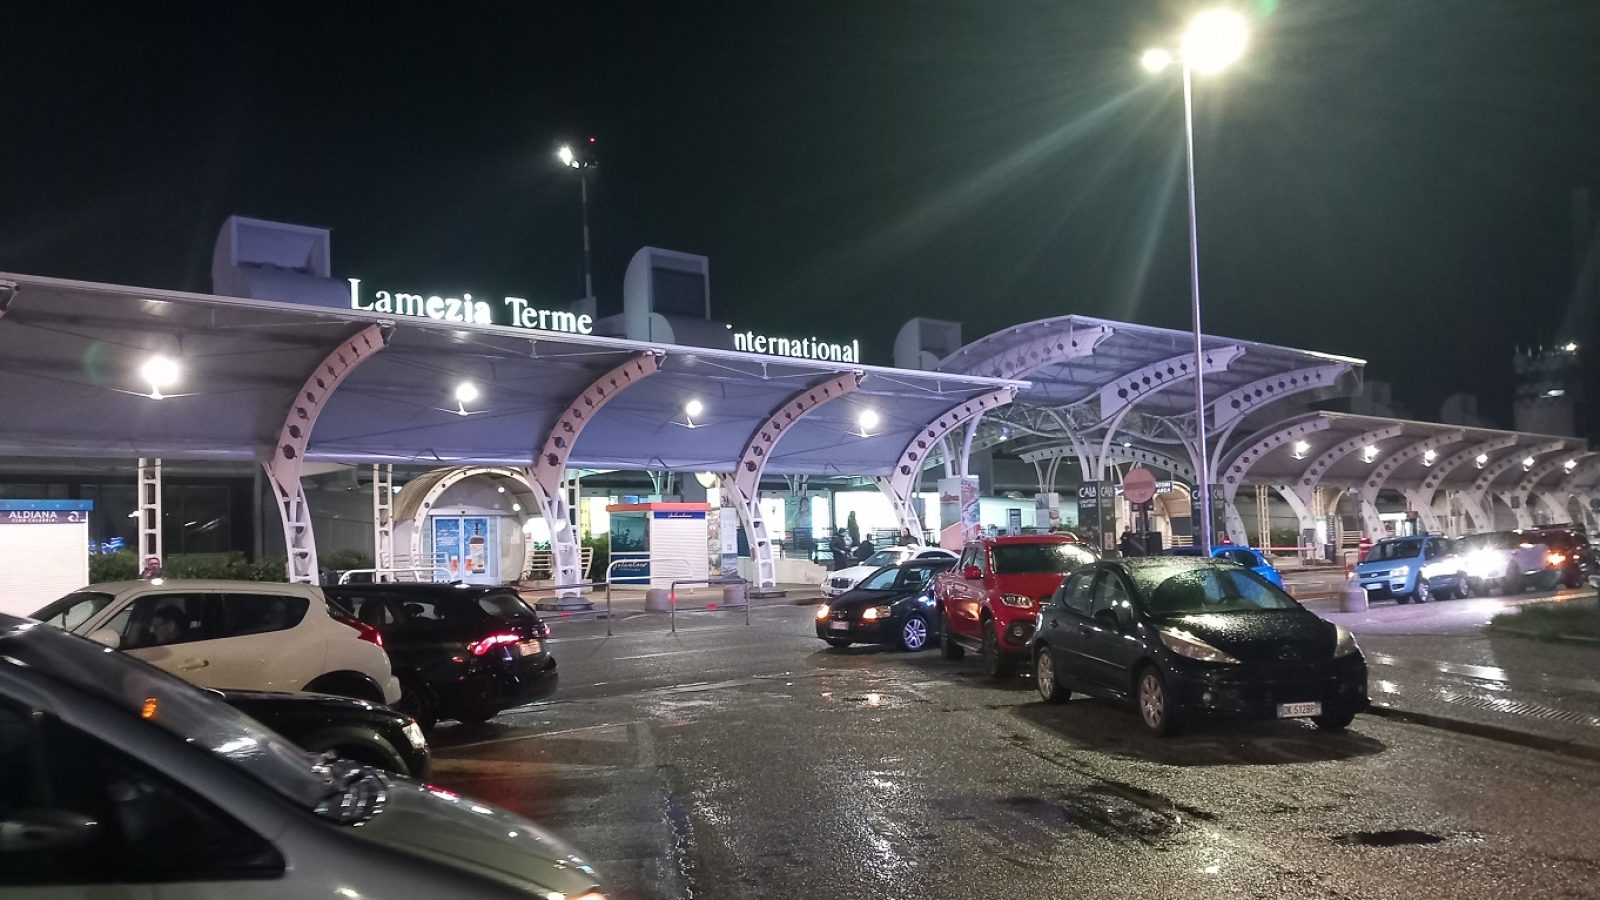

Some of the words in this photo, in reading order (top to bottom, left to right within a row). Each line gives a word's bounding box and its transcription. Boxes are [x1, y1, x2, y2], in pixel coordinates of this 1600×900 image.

[348, 278, 492, 325] Lamezia
[504, 296, 593, 335] Terme
[726, 324, 860, 364] nternational
[8, 510, 58, 519] ALDIANA
